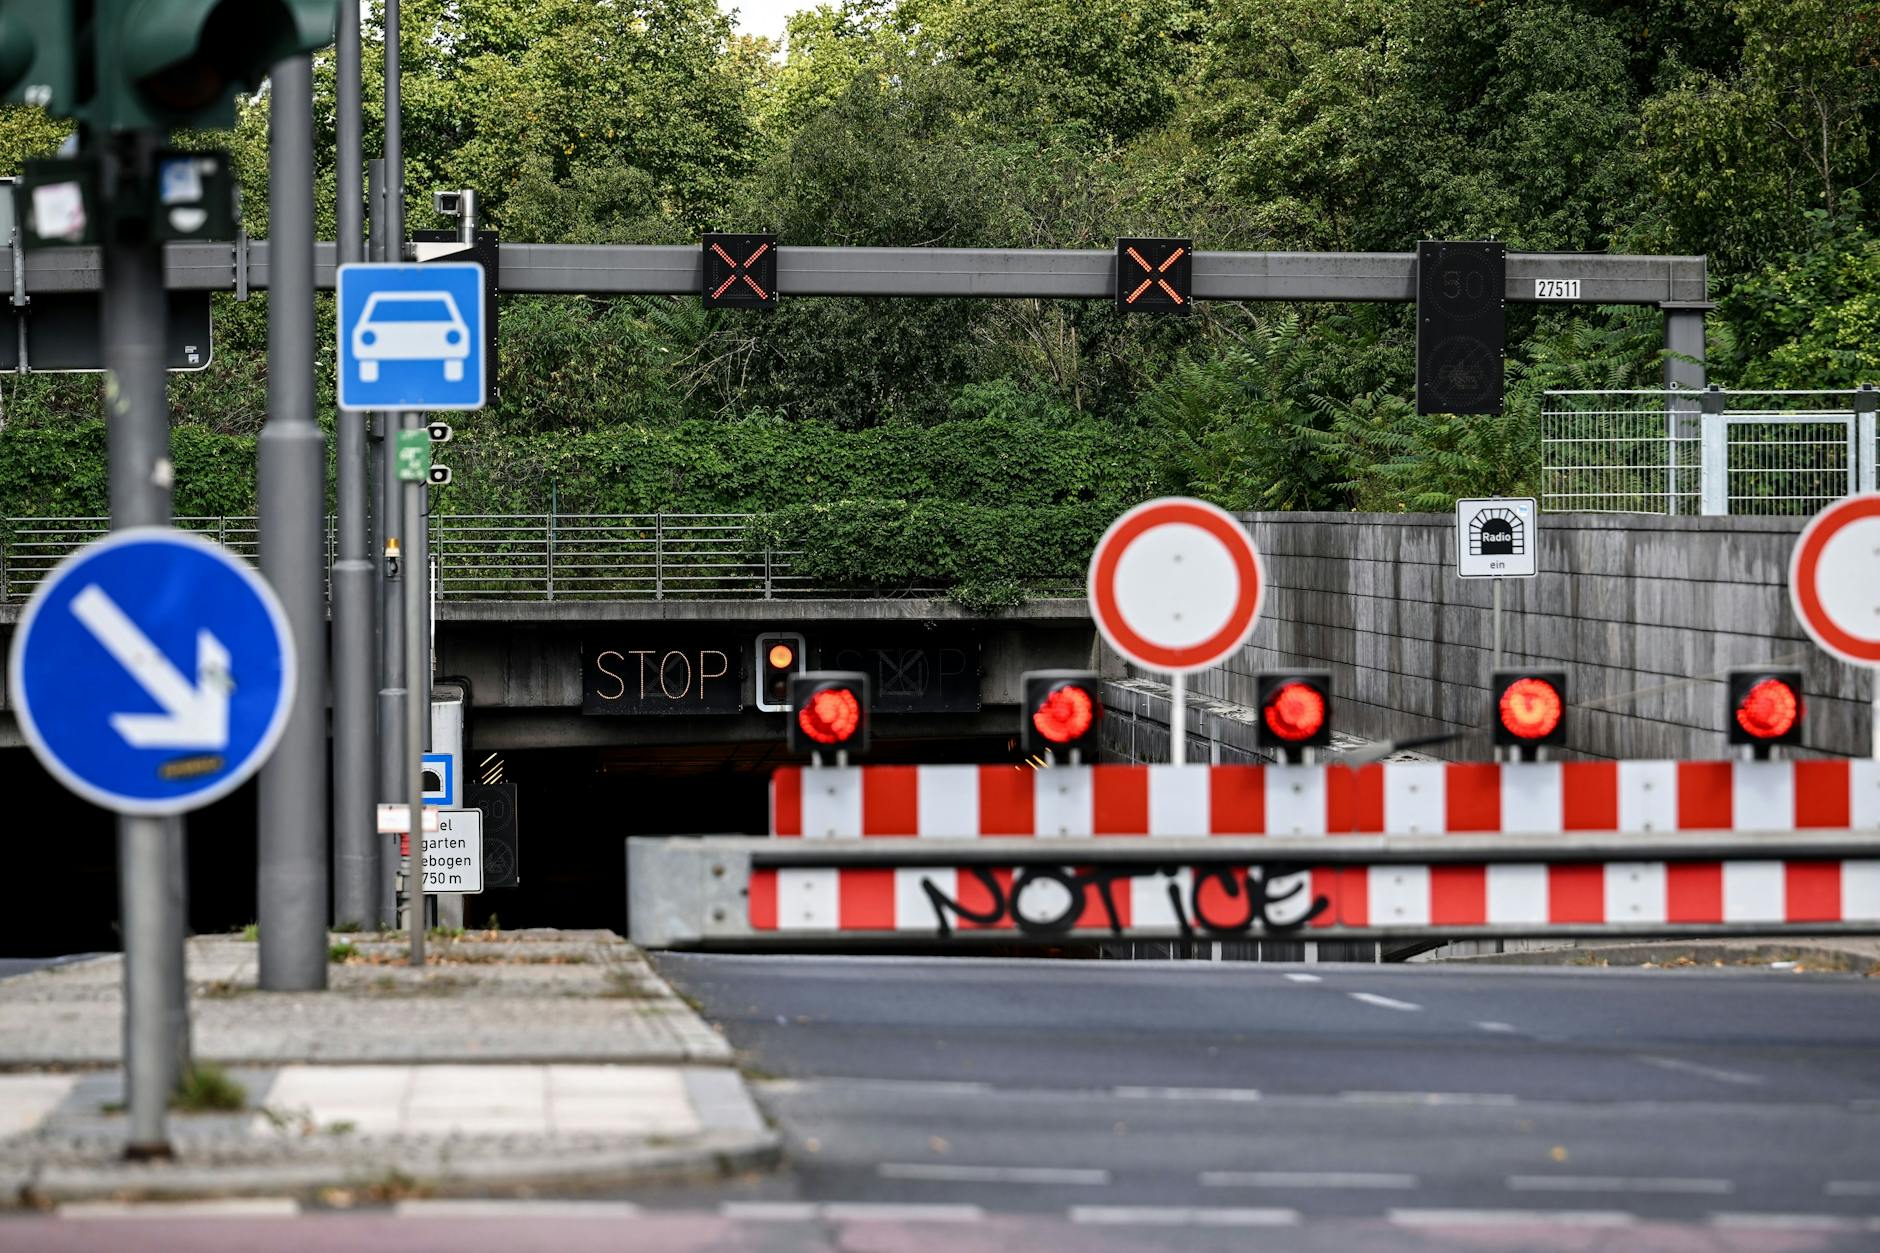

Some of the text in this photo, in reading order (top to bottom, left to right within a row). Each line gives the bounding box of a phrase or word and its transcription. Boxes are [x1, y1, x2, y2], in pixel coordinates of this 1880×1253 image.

[1538, 281, 1578, 298] 27511
[1482, 531, 1512, 543] Radio
[1489, 561, 1505, 569] ein
[596, 650, 728, 700] STOP
[422, 838, 466, 852] garten
[422, 855, 471, 869] ebogen
[449, 875, 462, 884] m
